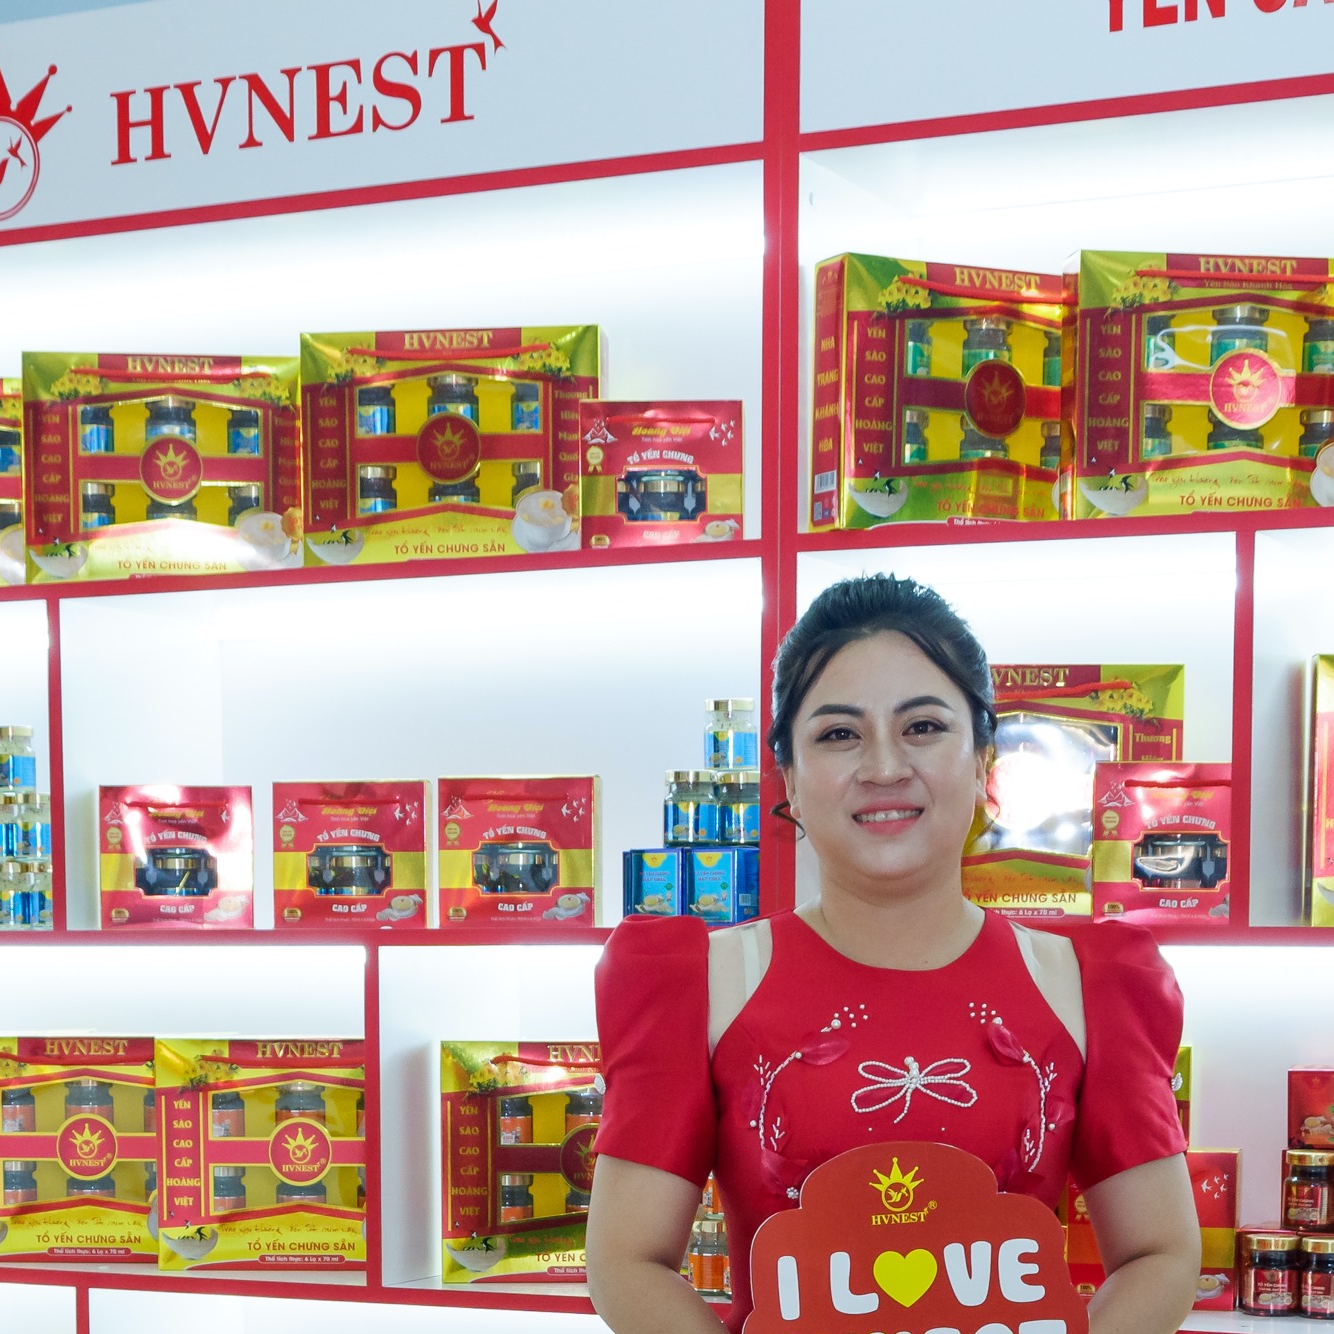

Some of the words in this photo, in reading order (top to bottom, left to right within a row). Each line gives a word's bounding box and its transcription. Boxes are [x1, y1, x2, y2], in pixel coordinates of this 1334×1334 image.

[110, 42, 487, 165] HVNEST
[1198, 257, 1298, 276] HVNEST
[955, 267, 1041, 292] HVNEST
[403, 330, 493, 350] HVNEST
[126, 355, 213, 373] HVNEST
[332, 904, 349, 913] CAO
[44, 1039, 128, 1056] HVNEST
[256, 1041, 343, 1058] HVNEST
[173, 1098, 191, 1109] YẾN
[173, 1119, 192, 1129] SÀO
[173, 1139, 193, 1148] CAO
[69, 1159, 106, 1167] HVNEST
[174, 1158, 193, 1168] CẤP
[282, 1164, 319, 1172] HVNEST
[167, 1177, 201, 1186] HOÀNG
[173, 1197, 194, 1207] VIỆT
[871, 1211, 926, 1226] HVNEST
[53, 1232, 73, 1243] YẾN
[77, 1234, 116, 1244] CHƯNG
[265, 1240, 284, 1251] YẾN
[289, 1242, 330, 1251] CHƯNG
[777, 1256, 800, 1320] I
